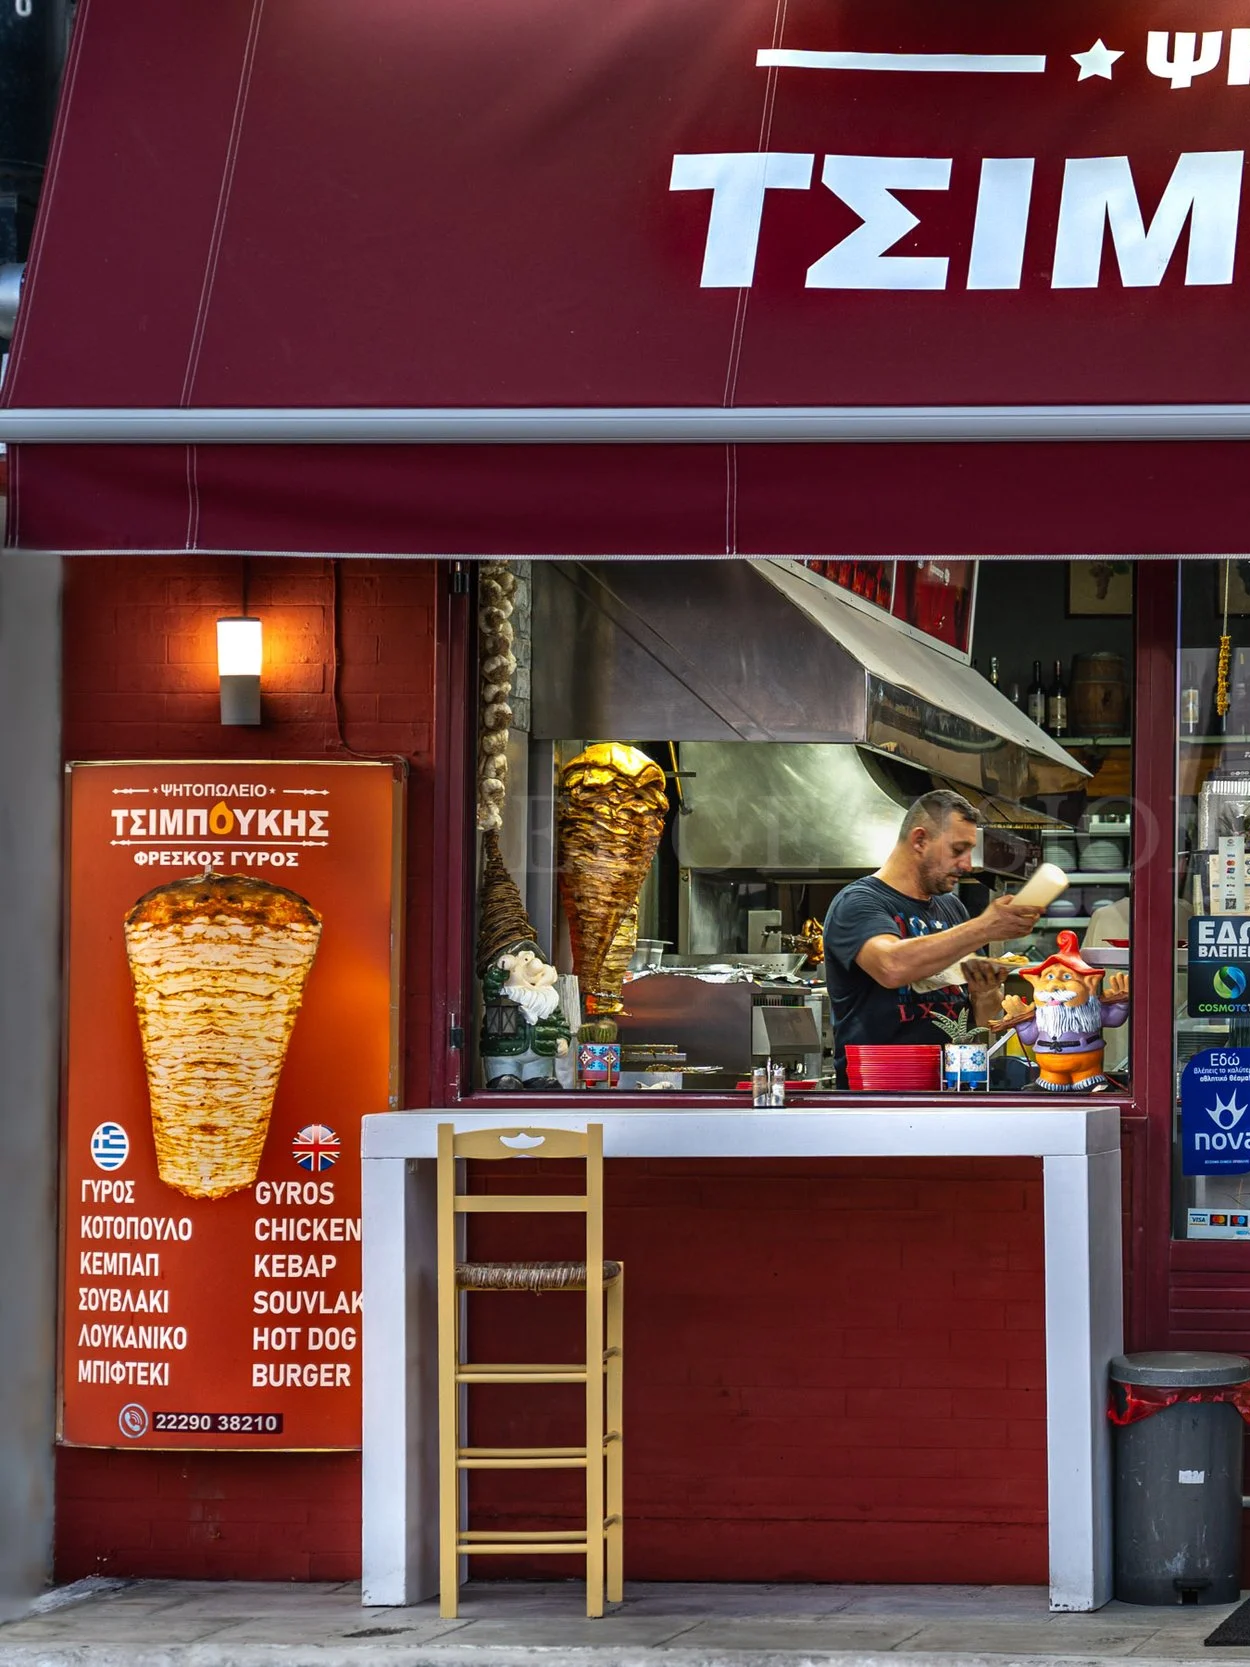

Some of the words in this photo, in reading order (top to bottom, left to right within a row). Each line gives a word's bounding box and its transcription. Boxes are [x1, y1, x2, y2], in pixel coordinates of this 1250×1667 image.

[160, 783, 268, 798] ΨΗΤΟΠΩΛΕΙΟ
[110, 800, 330, 838] ΤΣΙΜΠΟΥΚΗΣ
[133, 850, 225, 866] ΦΡΕΣΚΟΣ
[230, 851, 300, 867] ΓΥΡΟΣ
[1198, 1003, 1247, 1013] COSMOTE
[1210, 1052, 1241, 1067] Εδώ
[80, 1180, 136, 1204] ΓΥΡΟΣ
[254, 1181, 335, 1205] GYROS
[79, 1216, 193, 1241] ΚΟΤΟΠΟΥΛΟ
[253, 1217, 362, 1242] CHICKEN
[79, 1252, 160, 1277] ΚΕΜΠΑΠ
[253, 1254, 338, 1278] KEBAP
[78, 1287, 170, 1314] ΣΟΥΒΛΑΚΙ
[77, 1324, 188, 1350] ΛΟΥΚΑΝΙΚΟ
[252, 1327, 302, 1351] HOT
[307, 1327, 357, 1351] DOG
[78, 1360, 170, 1387] ΜΠΙΦΤΕΚΙ
[252, 1363, 351, 1388] BURGER
[155, 1414, 212, 1431] 22290
[217, 1414, 278, 1432] 38210
